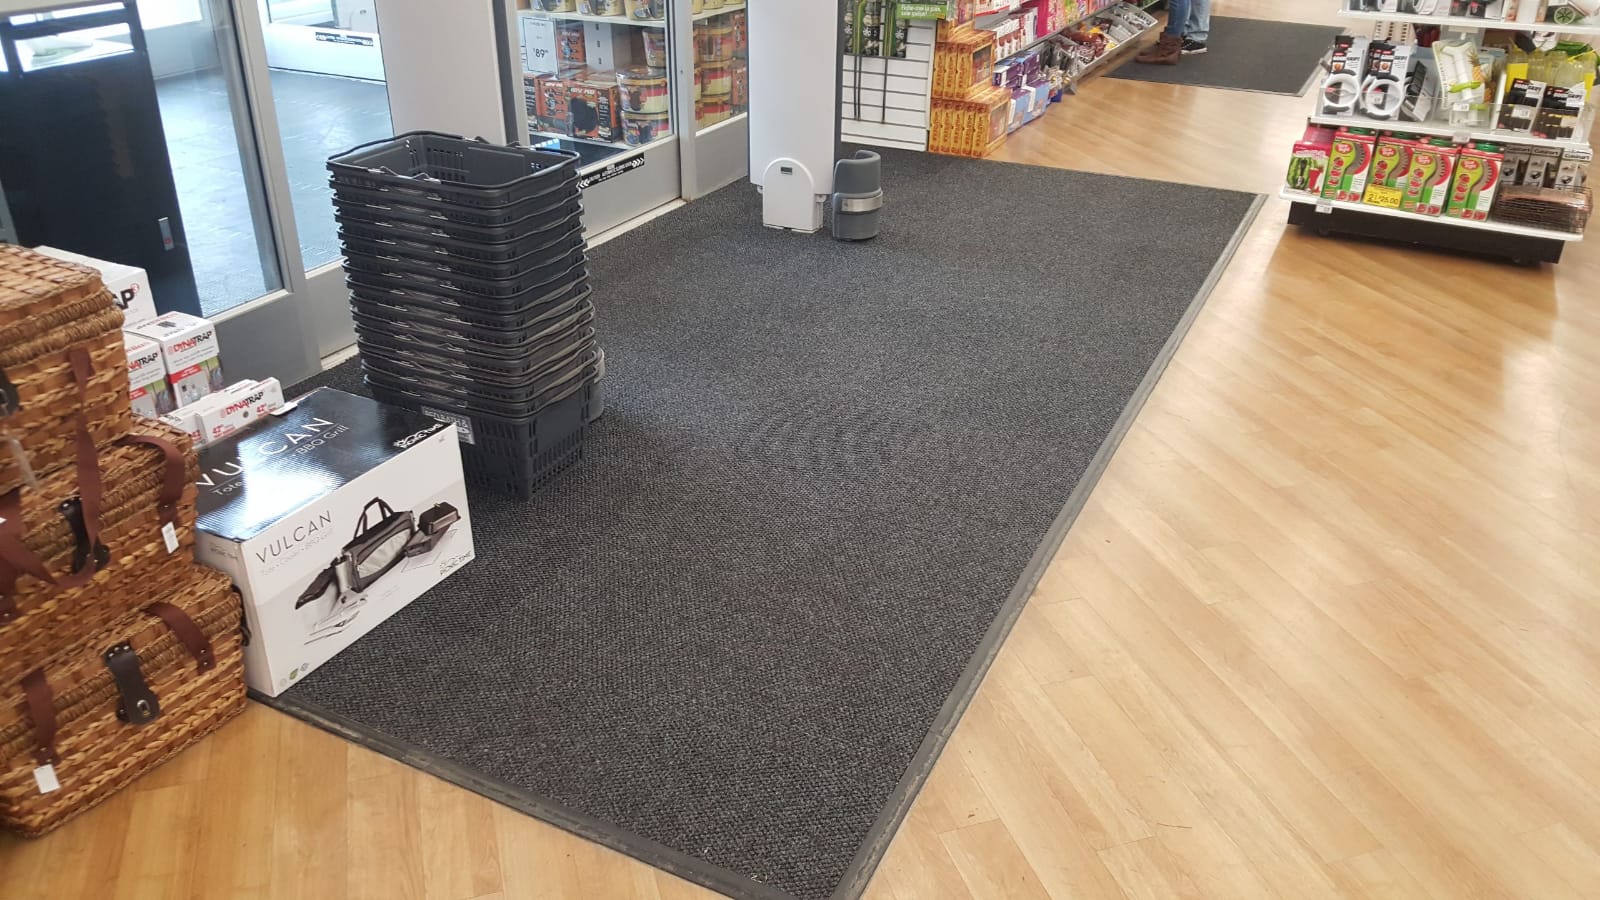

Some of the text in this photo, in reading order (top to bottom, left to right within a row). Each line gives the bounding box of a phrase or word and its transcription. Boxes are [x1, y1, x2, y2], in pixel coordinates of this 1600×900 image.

[173, 330, 213, 353] DYNATRAP
[226, 390, 264, 415] DYNATRAP
[323, 424, 350, 440] Grill
[255, 510, 332, 564] VULCAN
